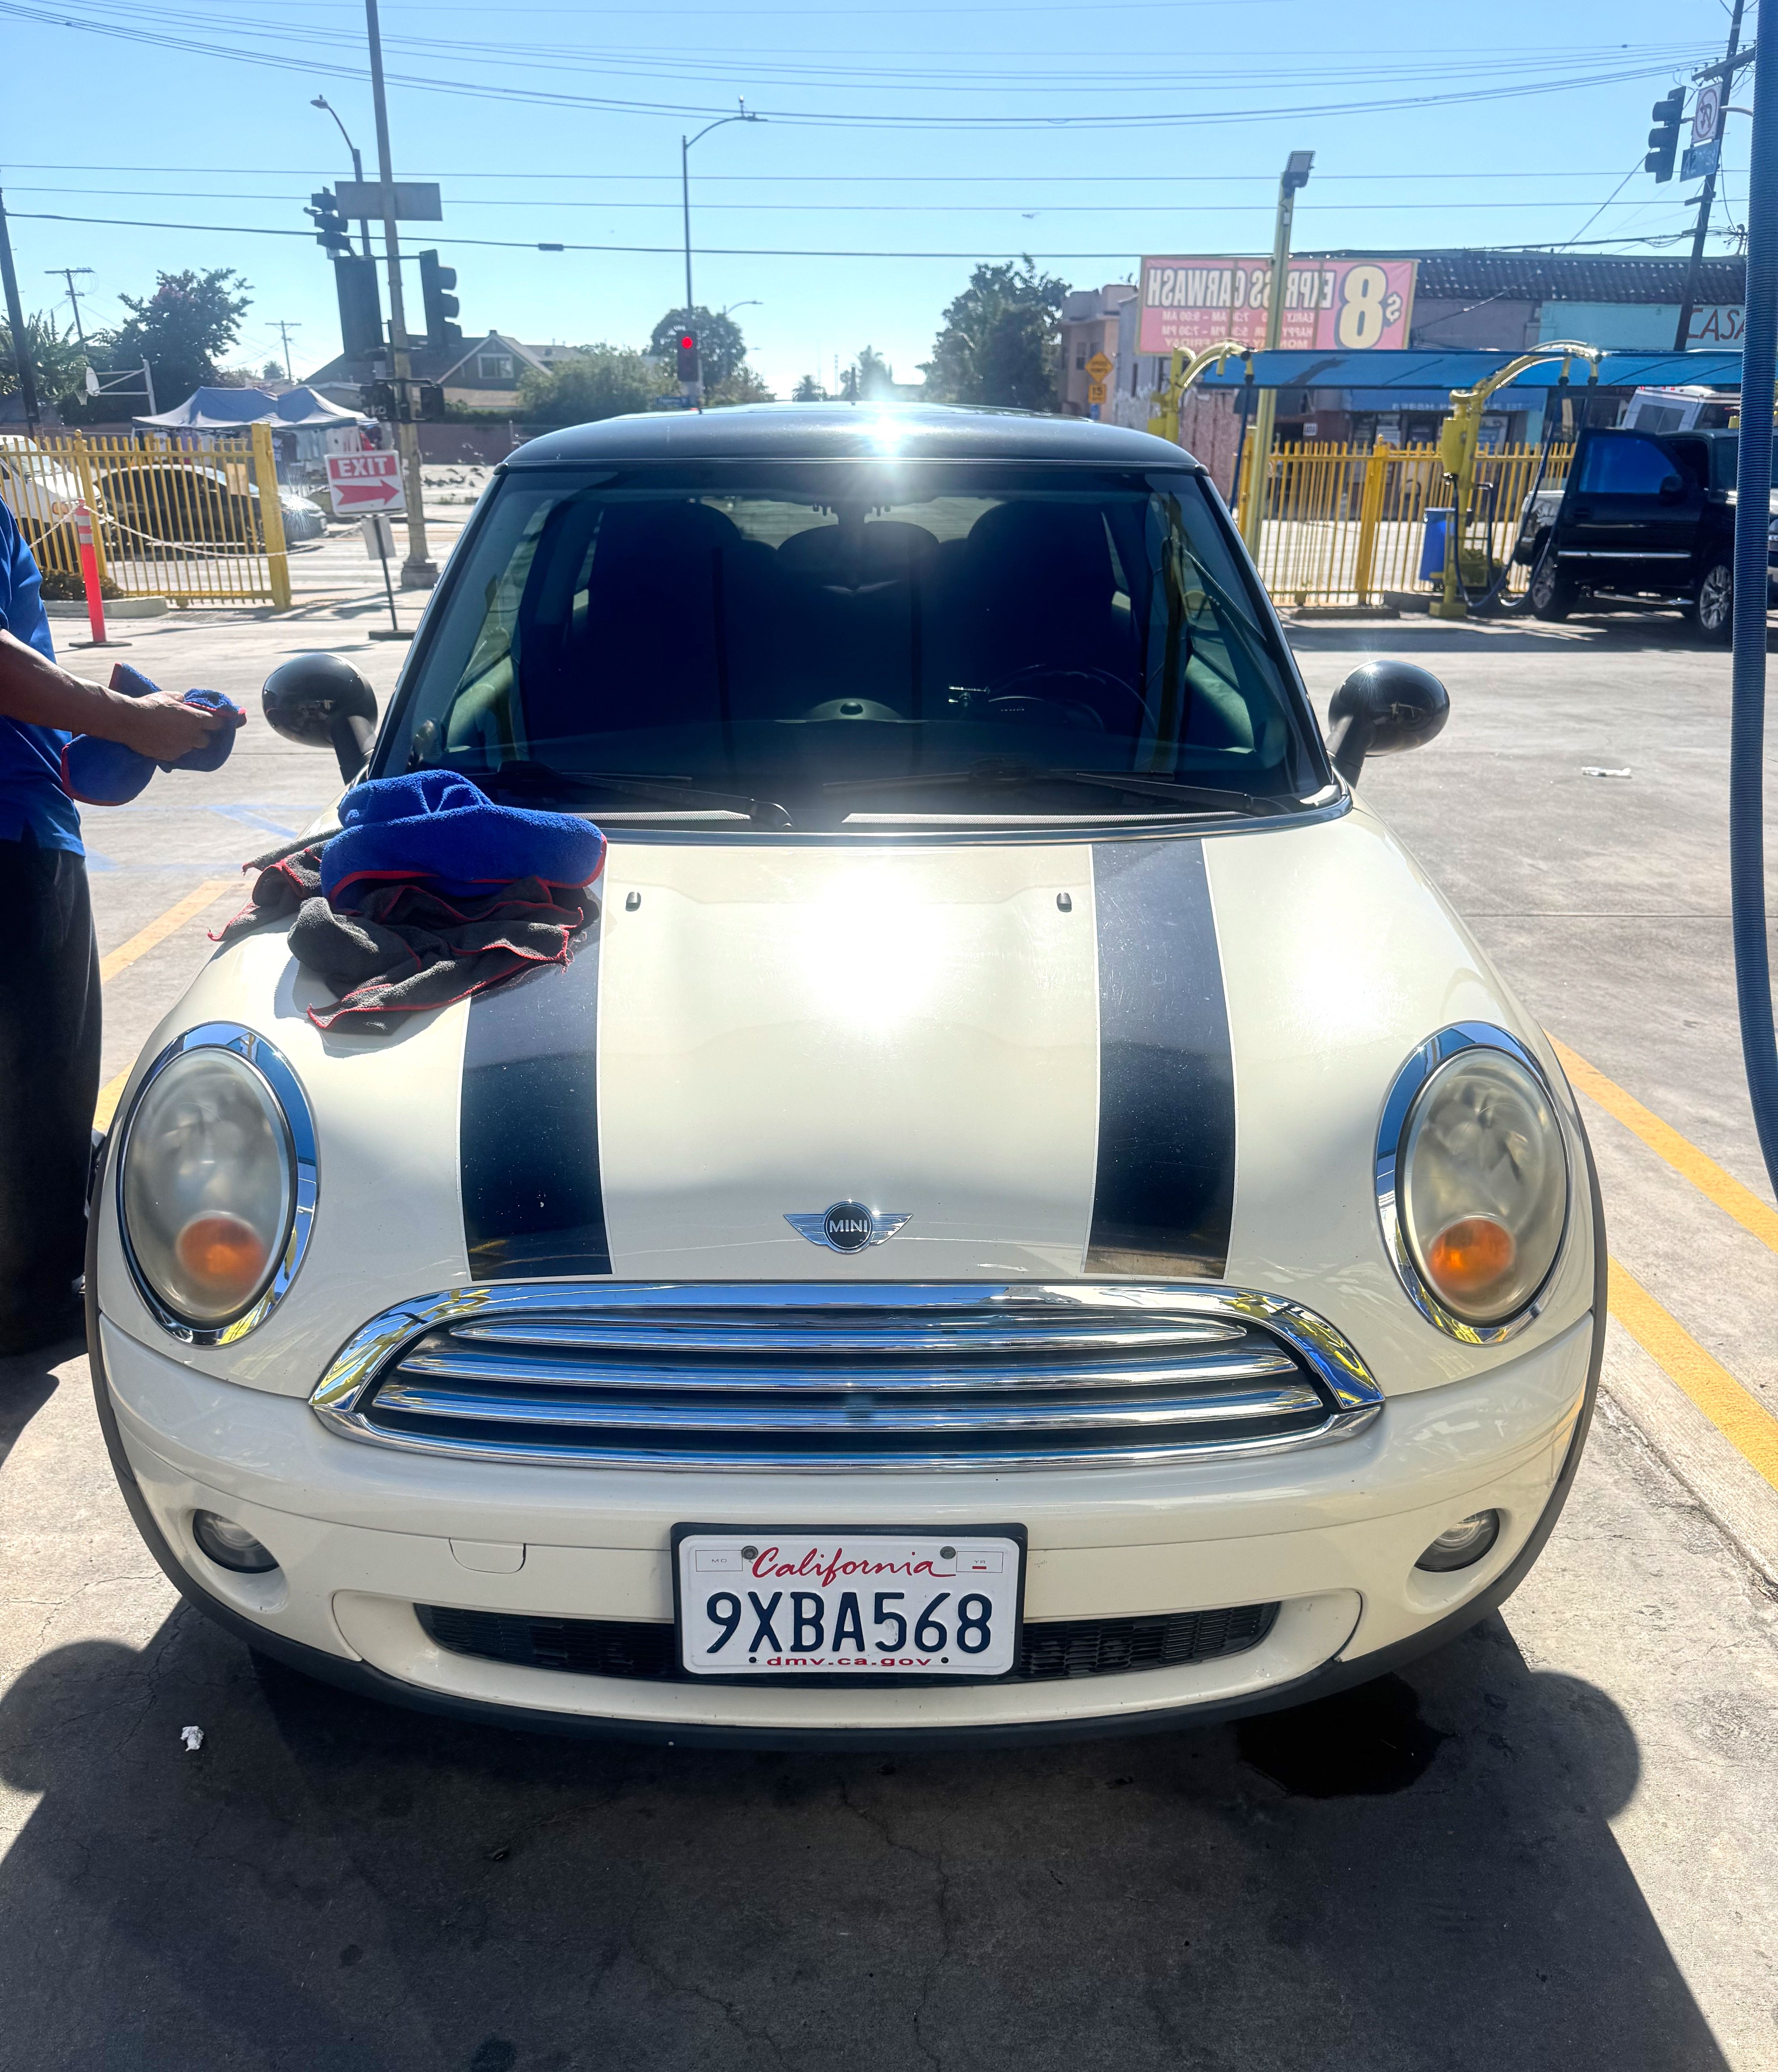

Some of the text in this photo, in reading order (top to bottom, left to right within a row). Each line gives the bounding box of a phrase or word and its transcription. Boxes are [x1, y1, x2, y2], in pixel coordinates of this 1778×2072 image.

[337, 457, 387, 477] EXIT
[830, 1219, 867, 1232] MINI
[752, 1547, 956, 1587] California
[706, 1591, 993, 1654] 9XBA568
[767, 1656, 932, 1666] dmv.ca.gov
